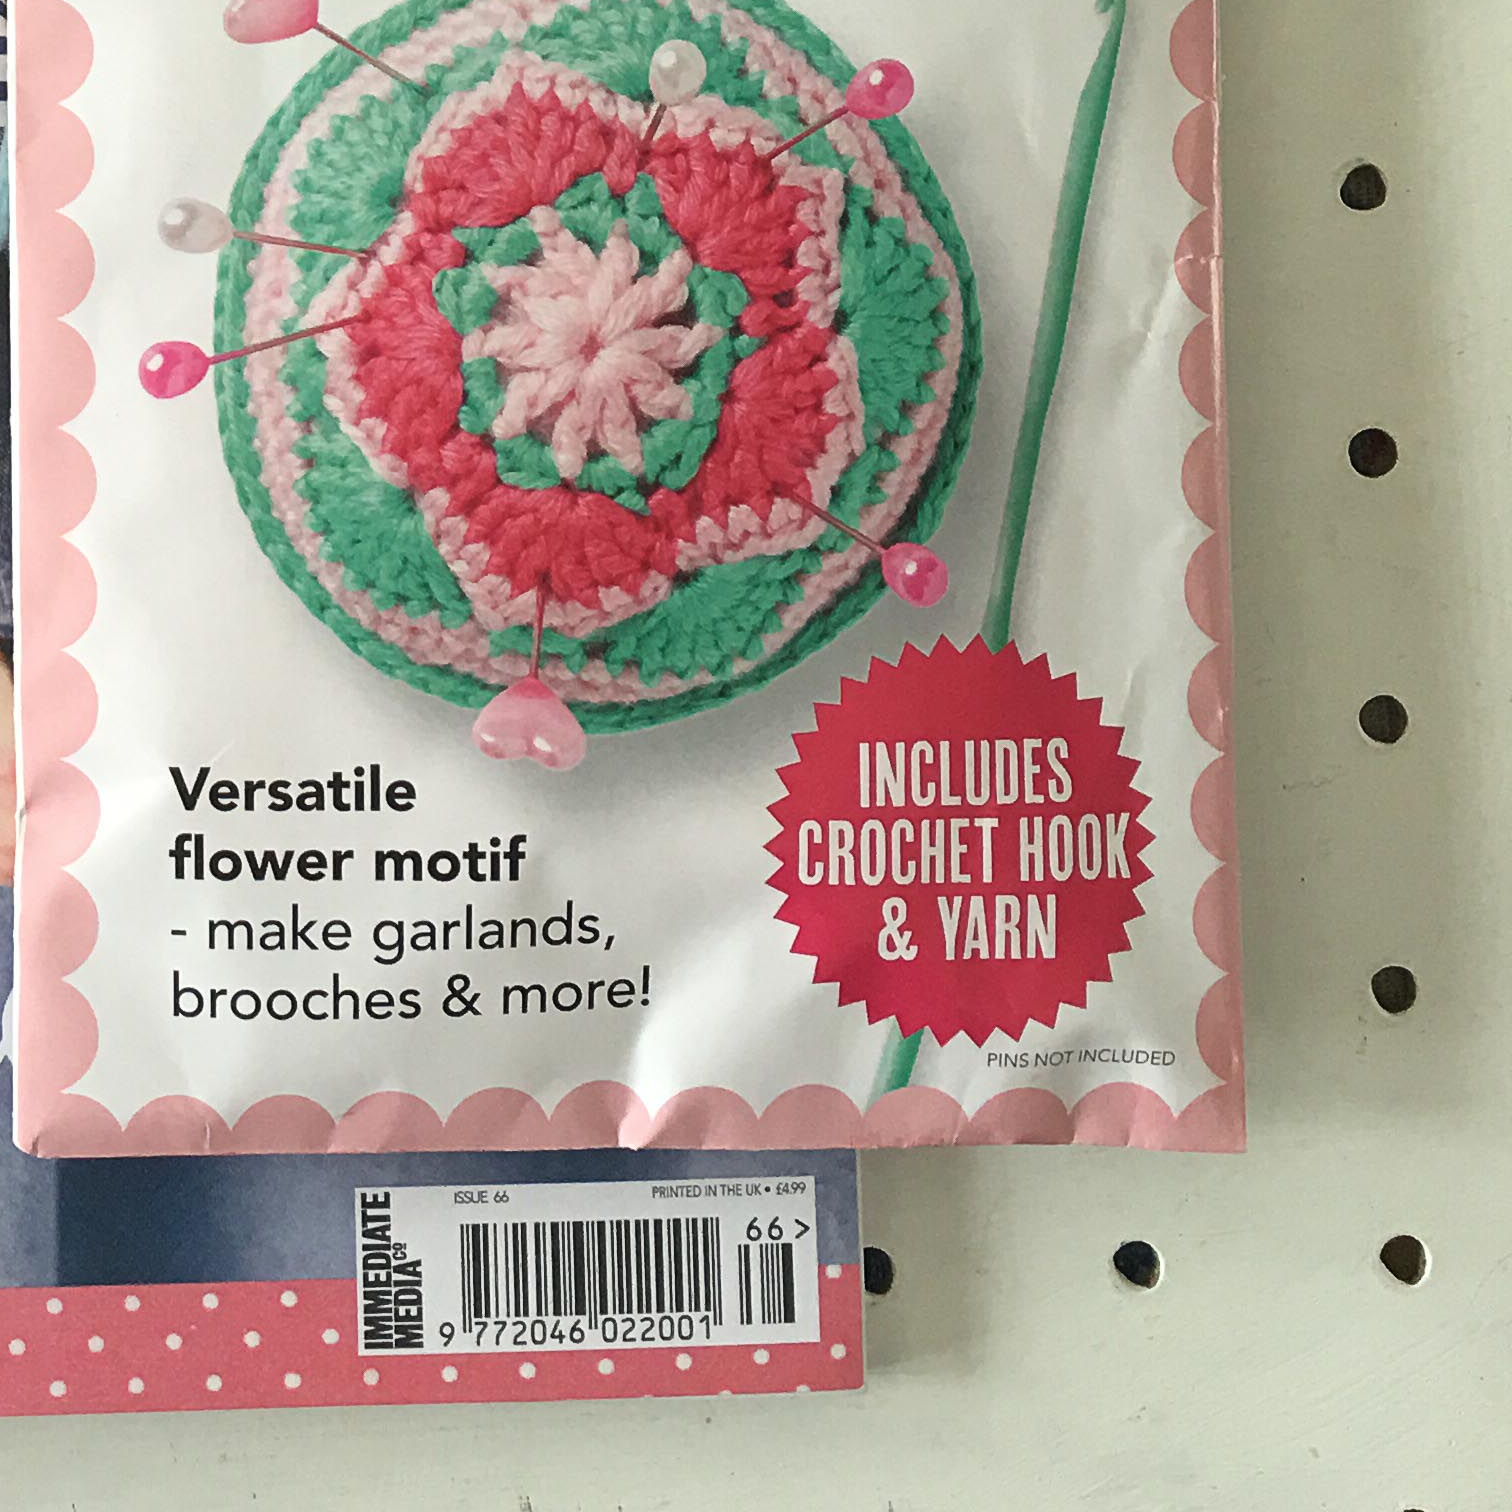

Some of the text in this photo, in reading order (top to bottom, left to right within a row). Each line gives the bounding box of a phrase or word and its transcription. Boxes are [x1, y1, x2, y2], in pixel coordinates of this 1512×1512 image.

[169, 764, 417, 813] Versatile
[858, 737, 1073, 808] INCLUDES
[169, 833, 528, 882] flower motif
[798, 812, 1131, 886] CROCHET HOOK
[207, 903, 352, 951] make
[372, 899, 617, 965] garlands,
[877, 893, 1057, 962] & YARN
[172, 964, 651, 1021] brooches & more!
[987, 1048, 1176, 1068] PINS NOT INCLUDED
[454, 1190, 510, 1204] ISSUE 66
[652, 1181, 807, 1198] PRINTED IN THE UK £4.99
[360, 1191, 394, 1349] IMMEDIATE
[392, 1259, 424, 1349] MEDIA
